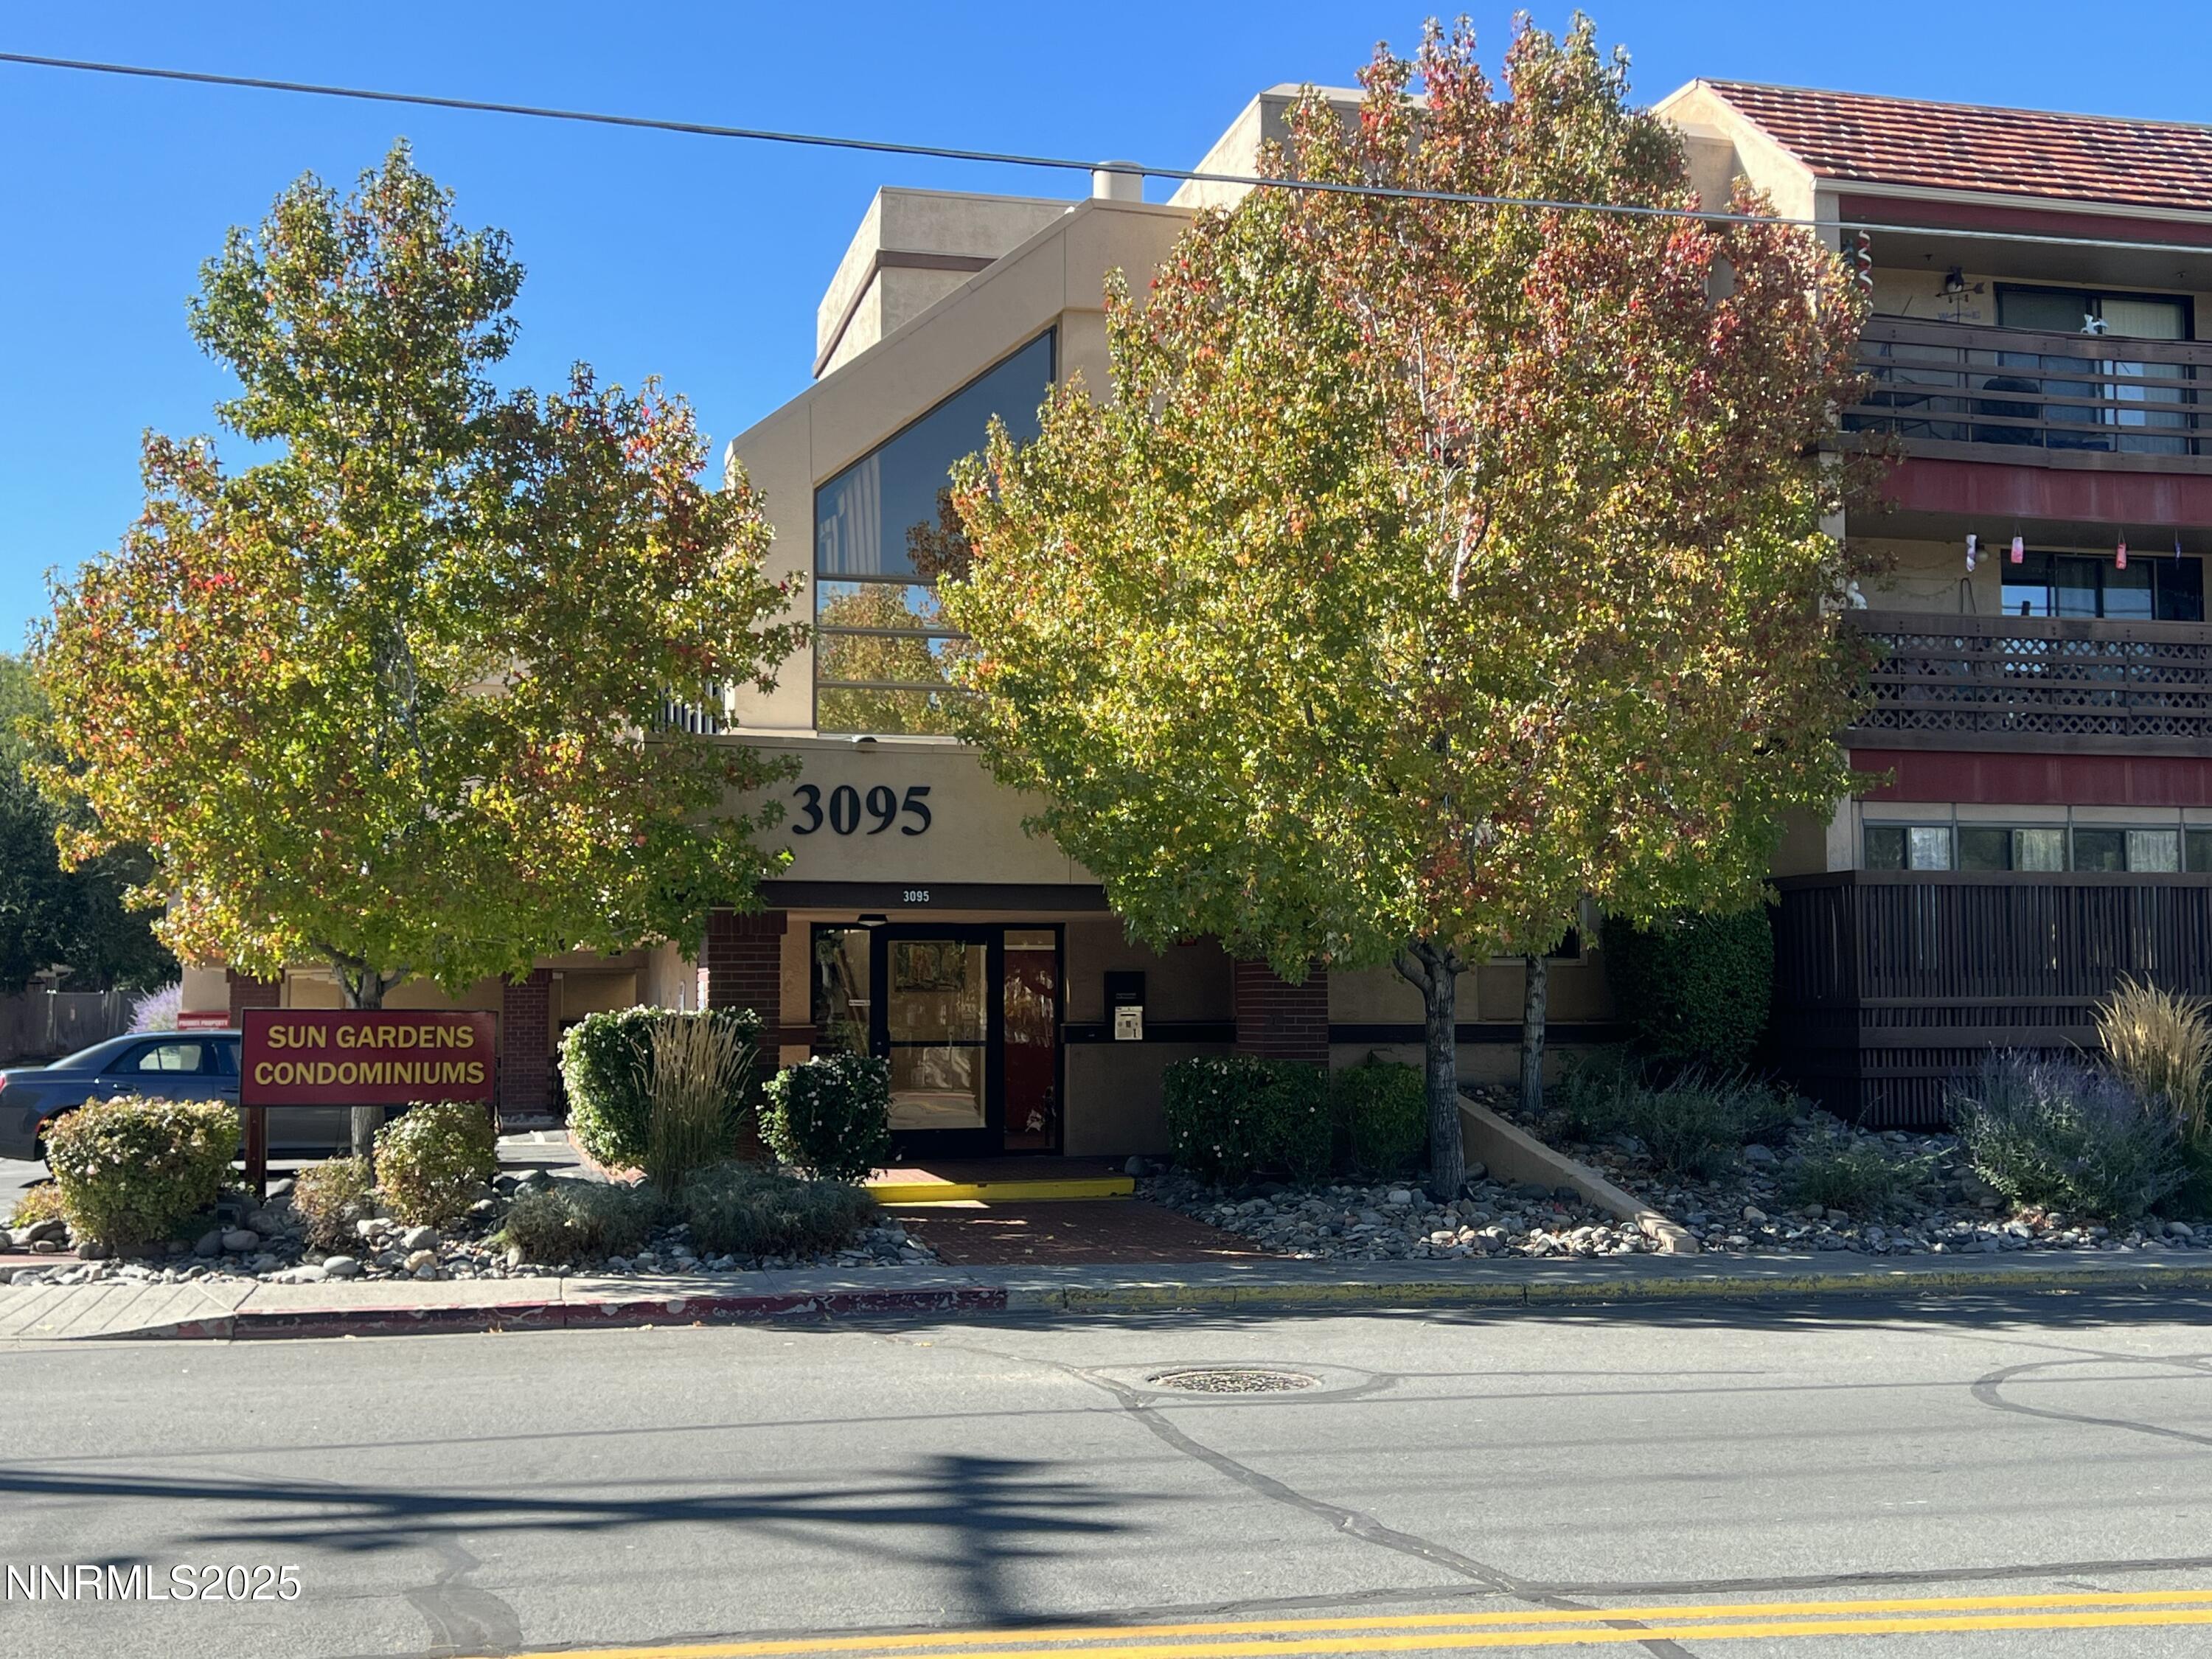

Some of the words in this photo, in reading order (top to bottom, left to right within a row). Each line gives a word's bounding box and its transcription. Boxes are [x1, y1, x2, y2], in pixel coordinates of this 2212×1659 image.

[792, 784, 931, 835] 3095
[903, 891, 930, 902] 3095
[267, 1025, 327, 1048] SUN
[335, 1025, 474, 1048] GARDENS
[254, 1062, 485, 1085] CONDOMINIUMS
